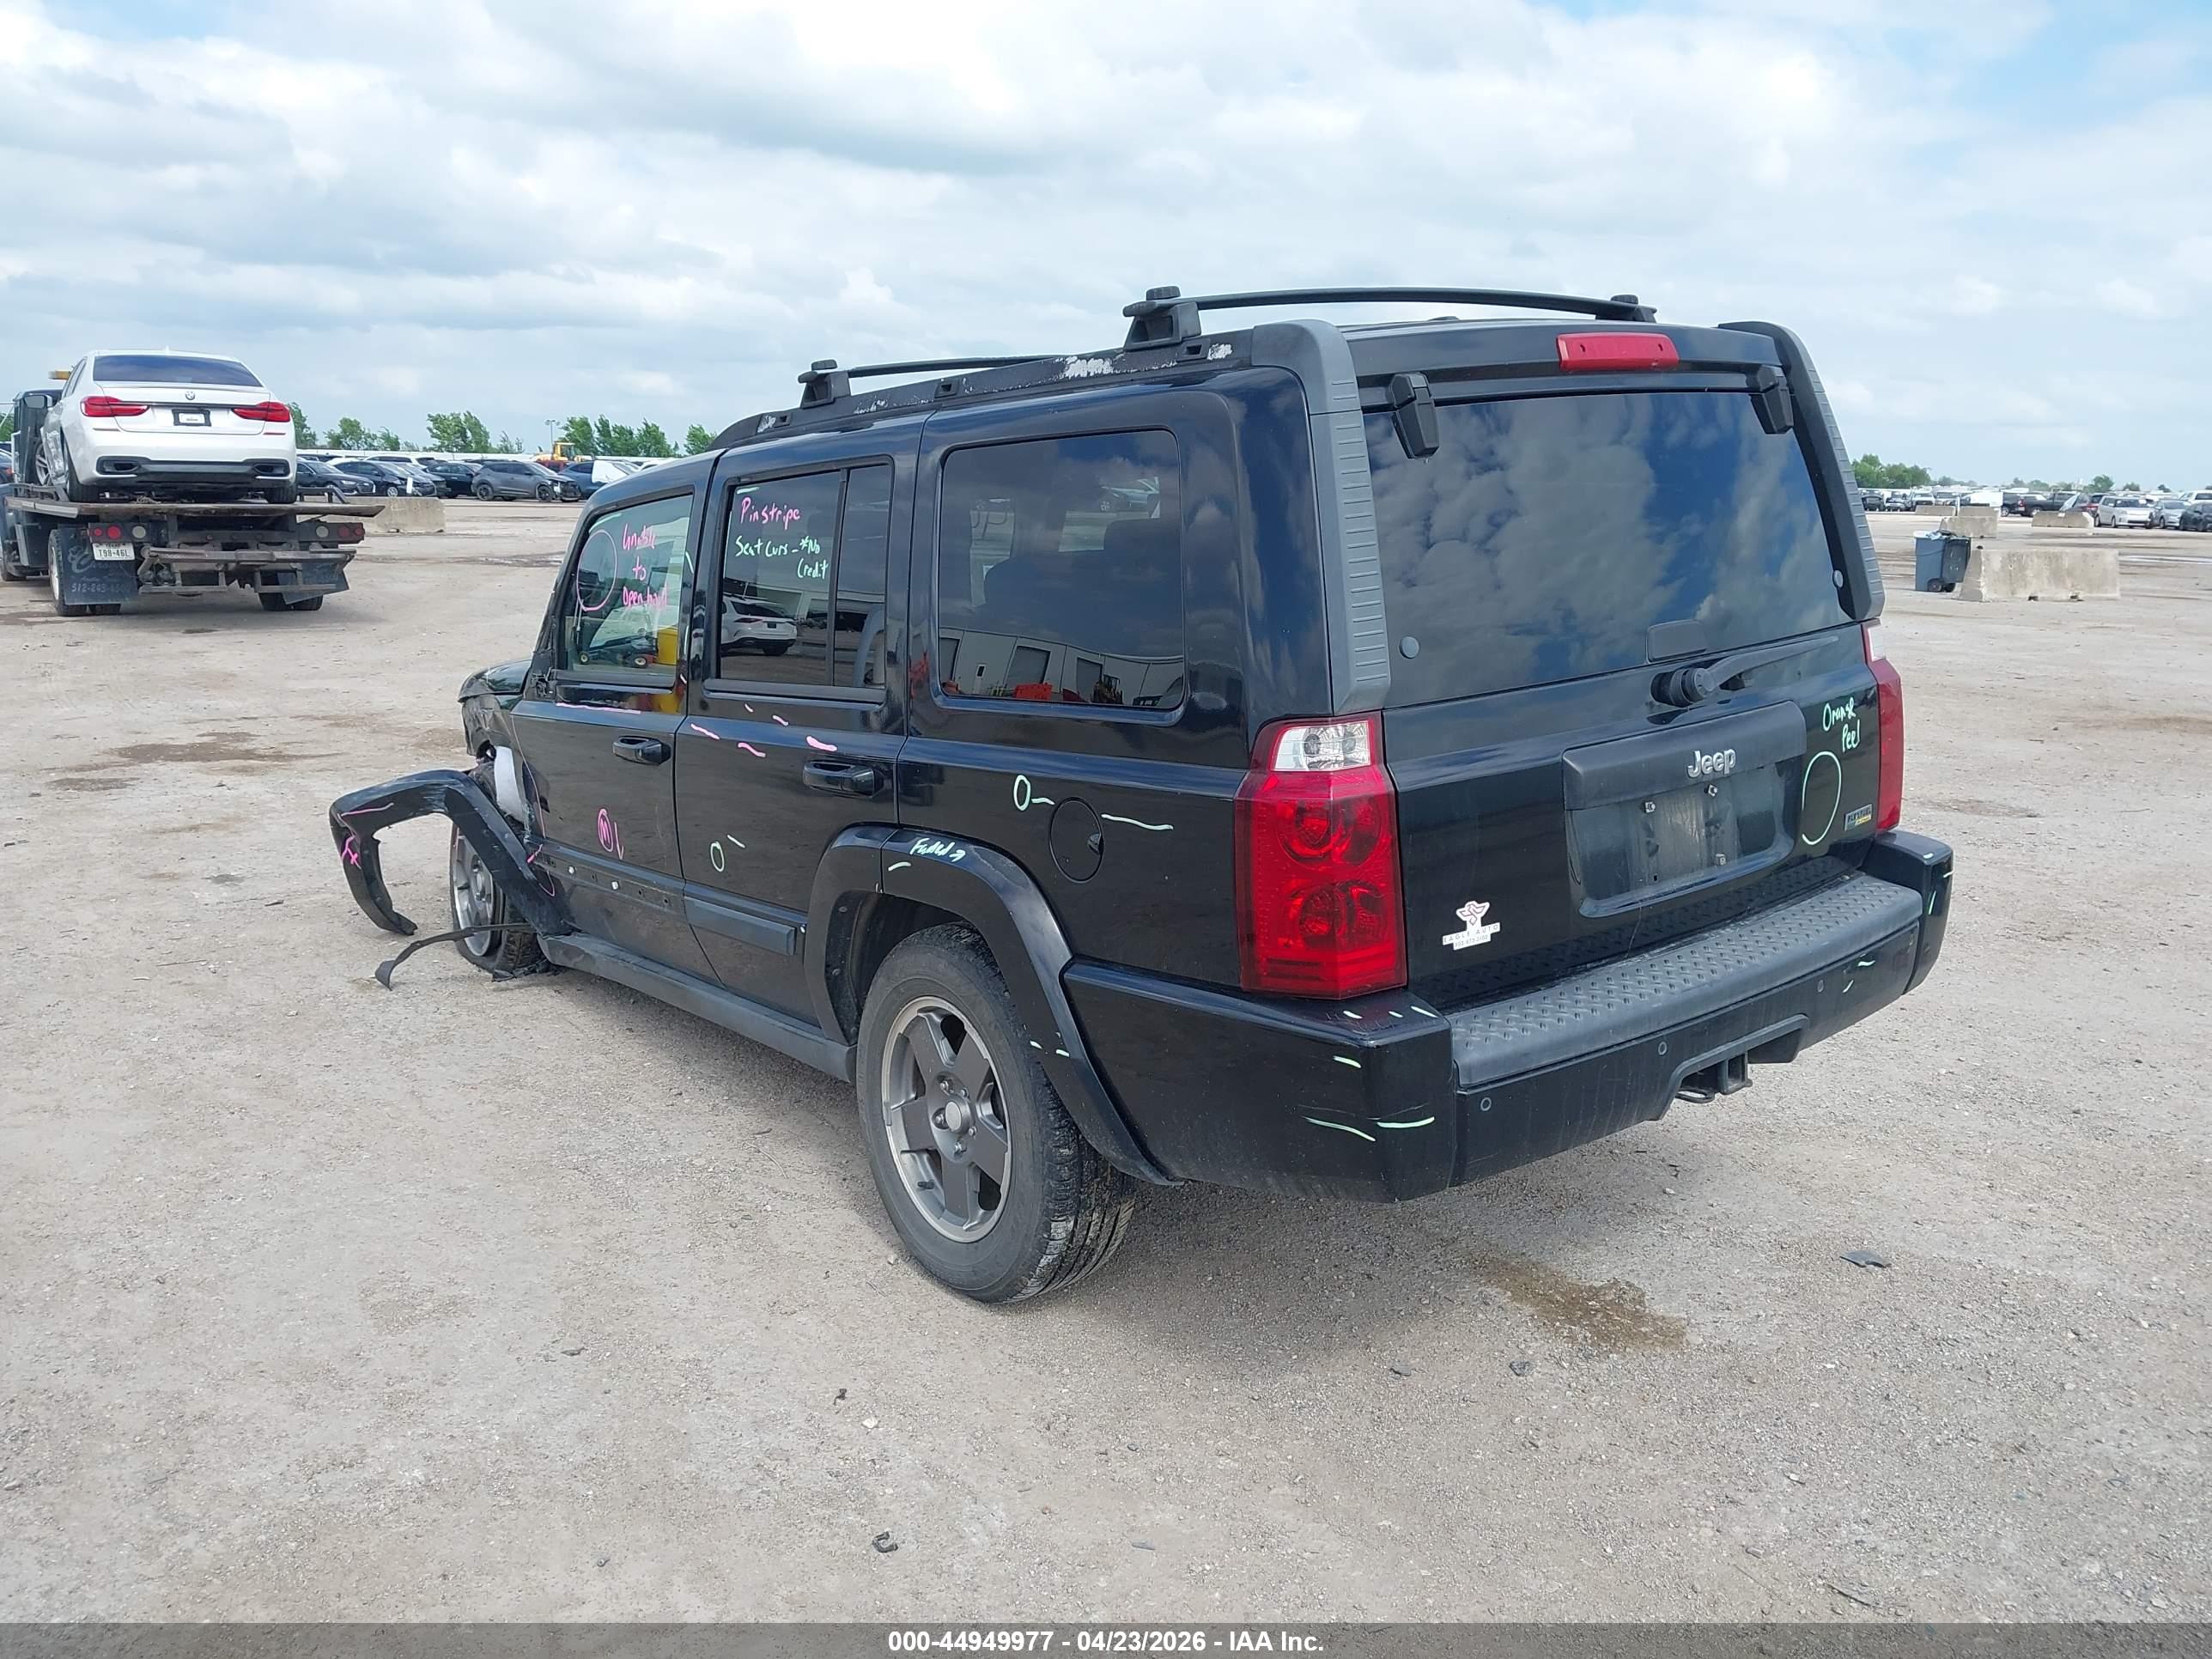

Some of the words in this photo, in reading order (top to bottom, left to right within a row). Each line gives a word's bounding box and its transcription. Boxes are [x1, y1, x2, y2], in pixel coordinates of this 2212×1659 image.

[741, 496, 800, 531] Pinstripe
[735, 535, 763, 556] Seat
[632, 556, 647, 580] to
[797, 557, 830, 580] Credit
[623, 586, 644, 607] Open
[1842, 719, 1861, 752] Peel
[1687, 749, 1736, 778] Jeep
[1443, 931, 1471, 944] EAGLE
[1476, 924, 1498, 934] AUTO
